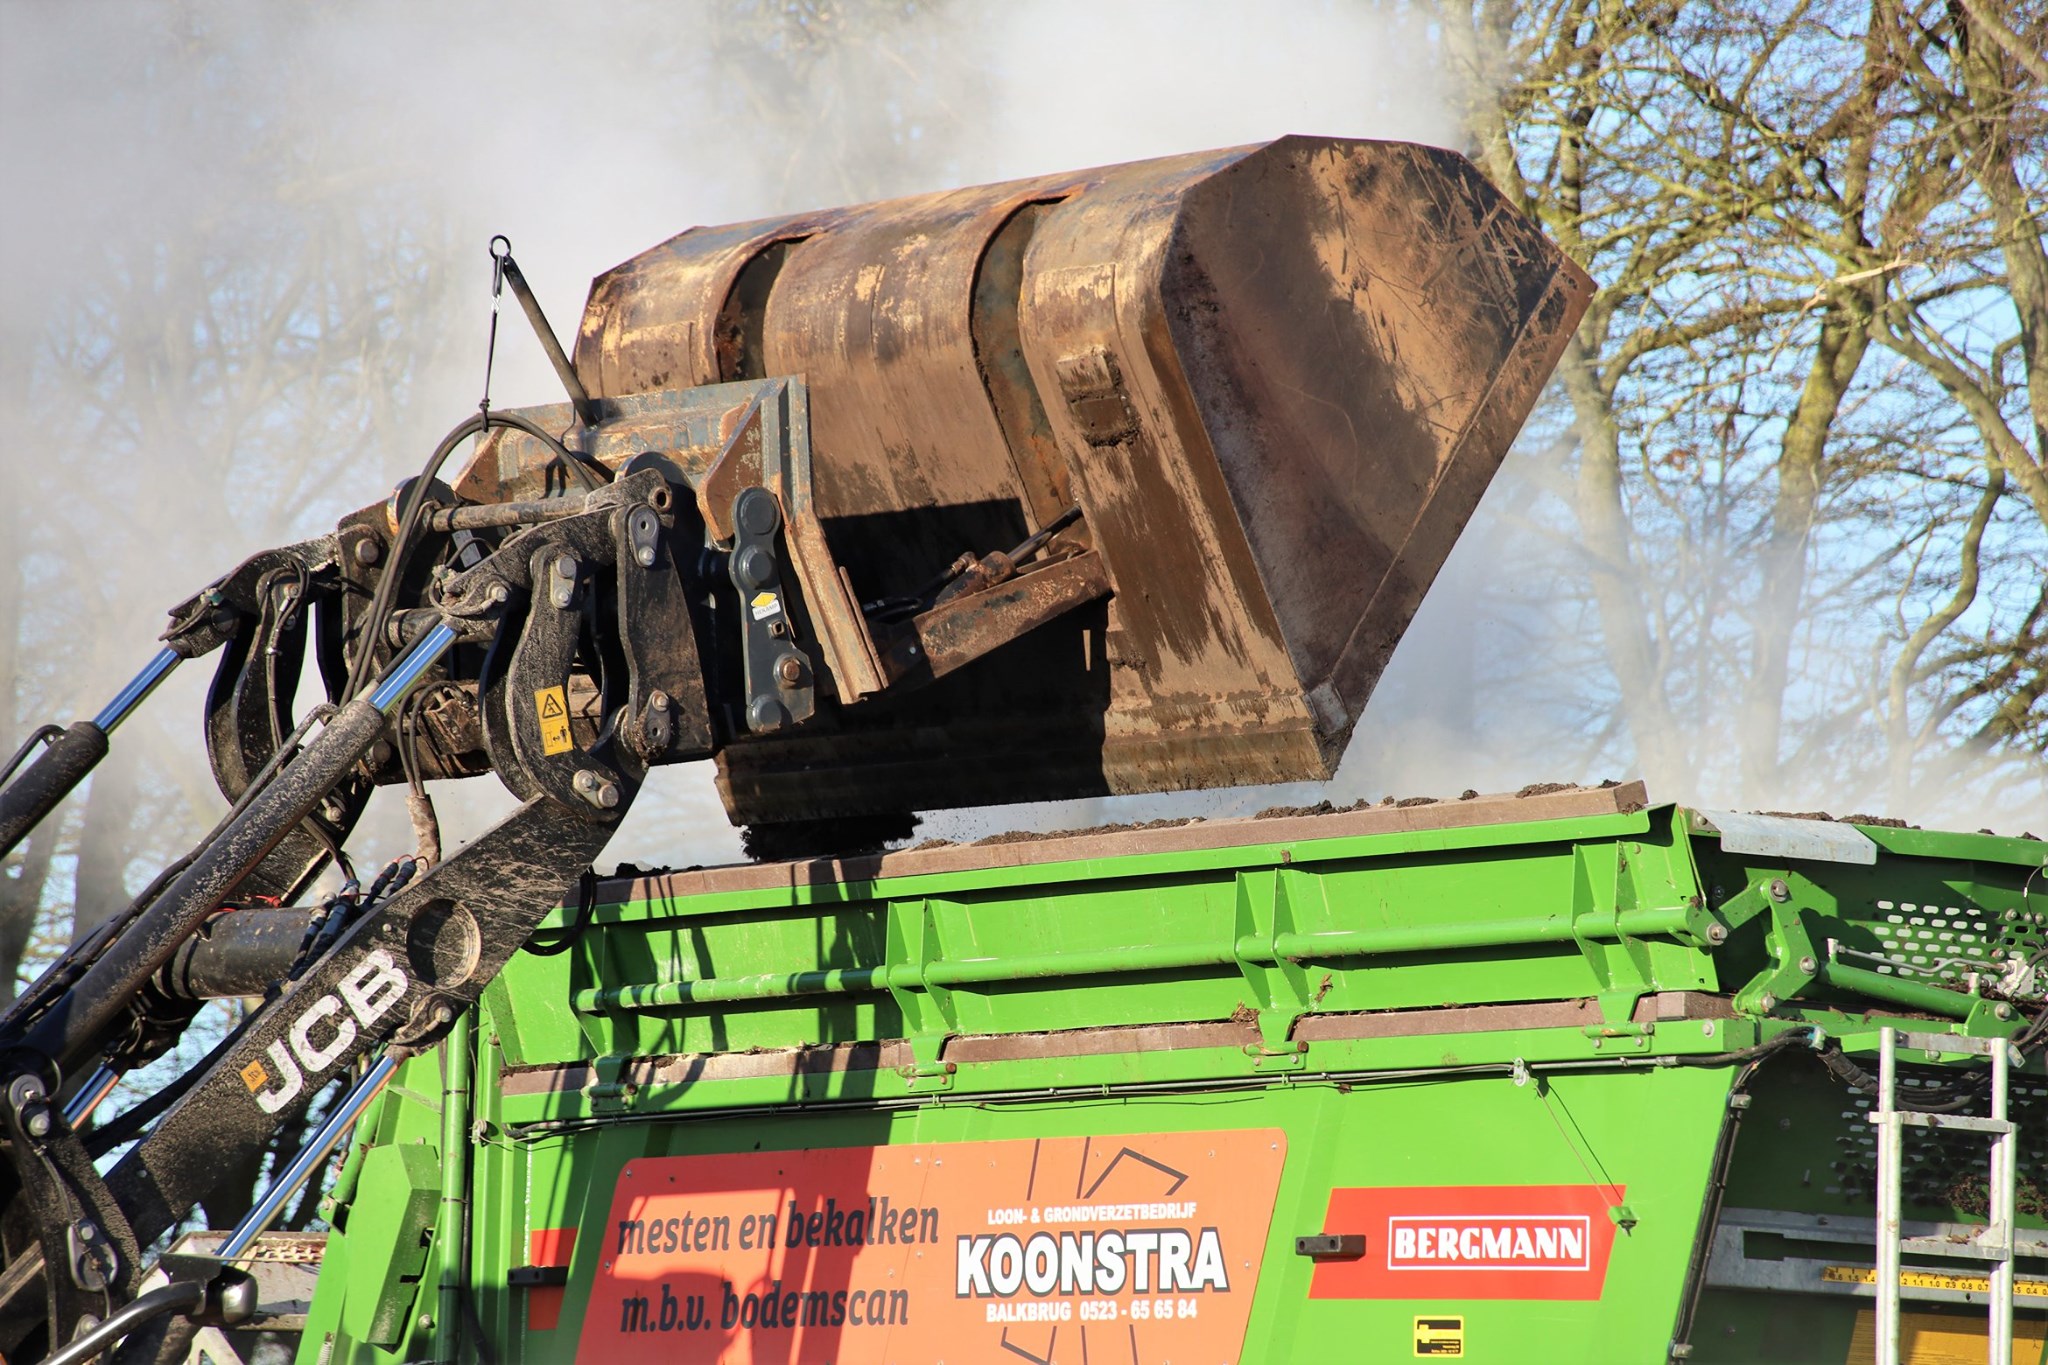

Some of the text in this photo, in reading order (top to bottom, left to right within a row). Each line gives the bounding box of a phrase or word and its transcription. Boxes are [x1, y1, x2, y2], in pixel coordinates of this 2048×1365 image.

[256, 948, 409, 1114] JCB
[618, 1196, 939, 1255] mesten en bekalken
[987, 1202, 1197, 1225] LOON- & GRONDVERZETBEDRIJF
[955, 1226, 1231, 1299] KOONSTRA
[1394, 1227, 1583, 1261] BERGMANN
[719, 1279, 909, 1331] bodemscan
[986, 1302, 1072, 1323] BALKBRUG
[1079, 1300, 1118, 1321] 0523
[1130, 1300, 1150, 1320] 65
[1153, 1299, 1174, 1319] 65
[1176, 1298, 1198, 1319] 84
